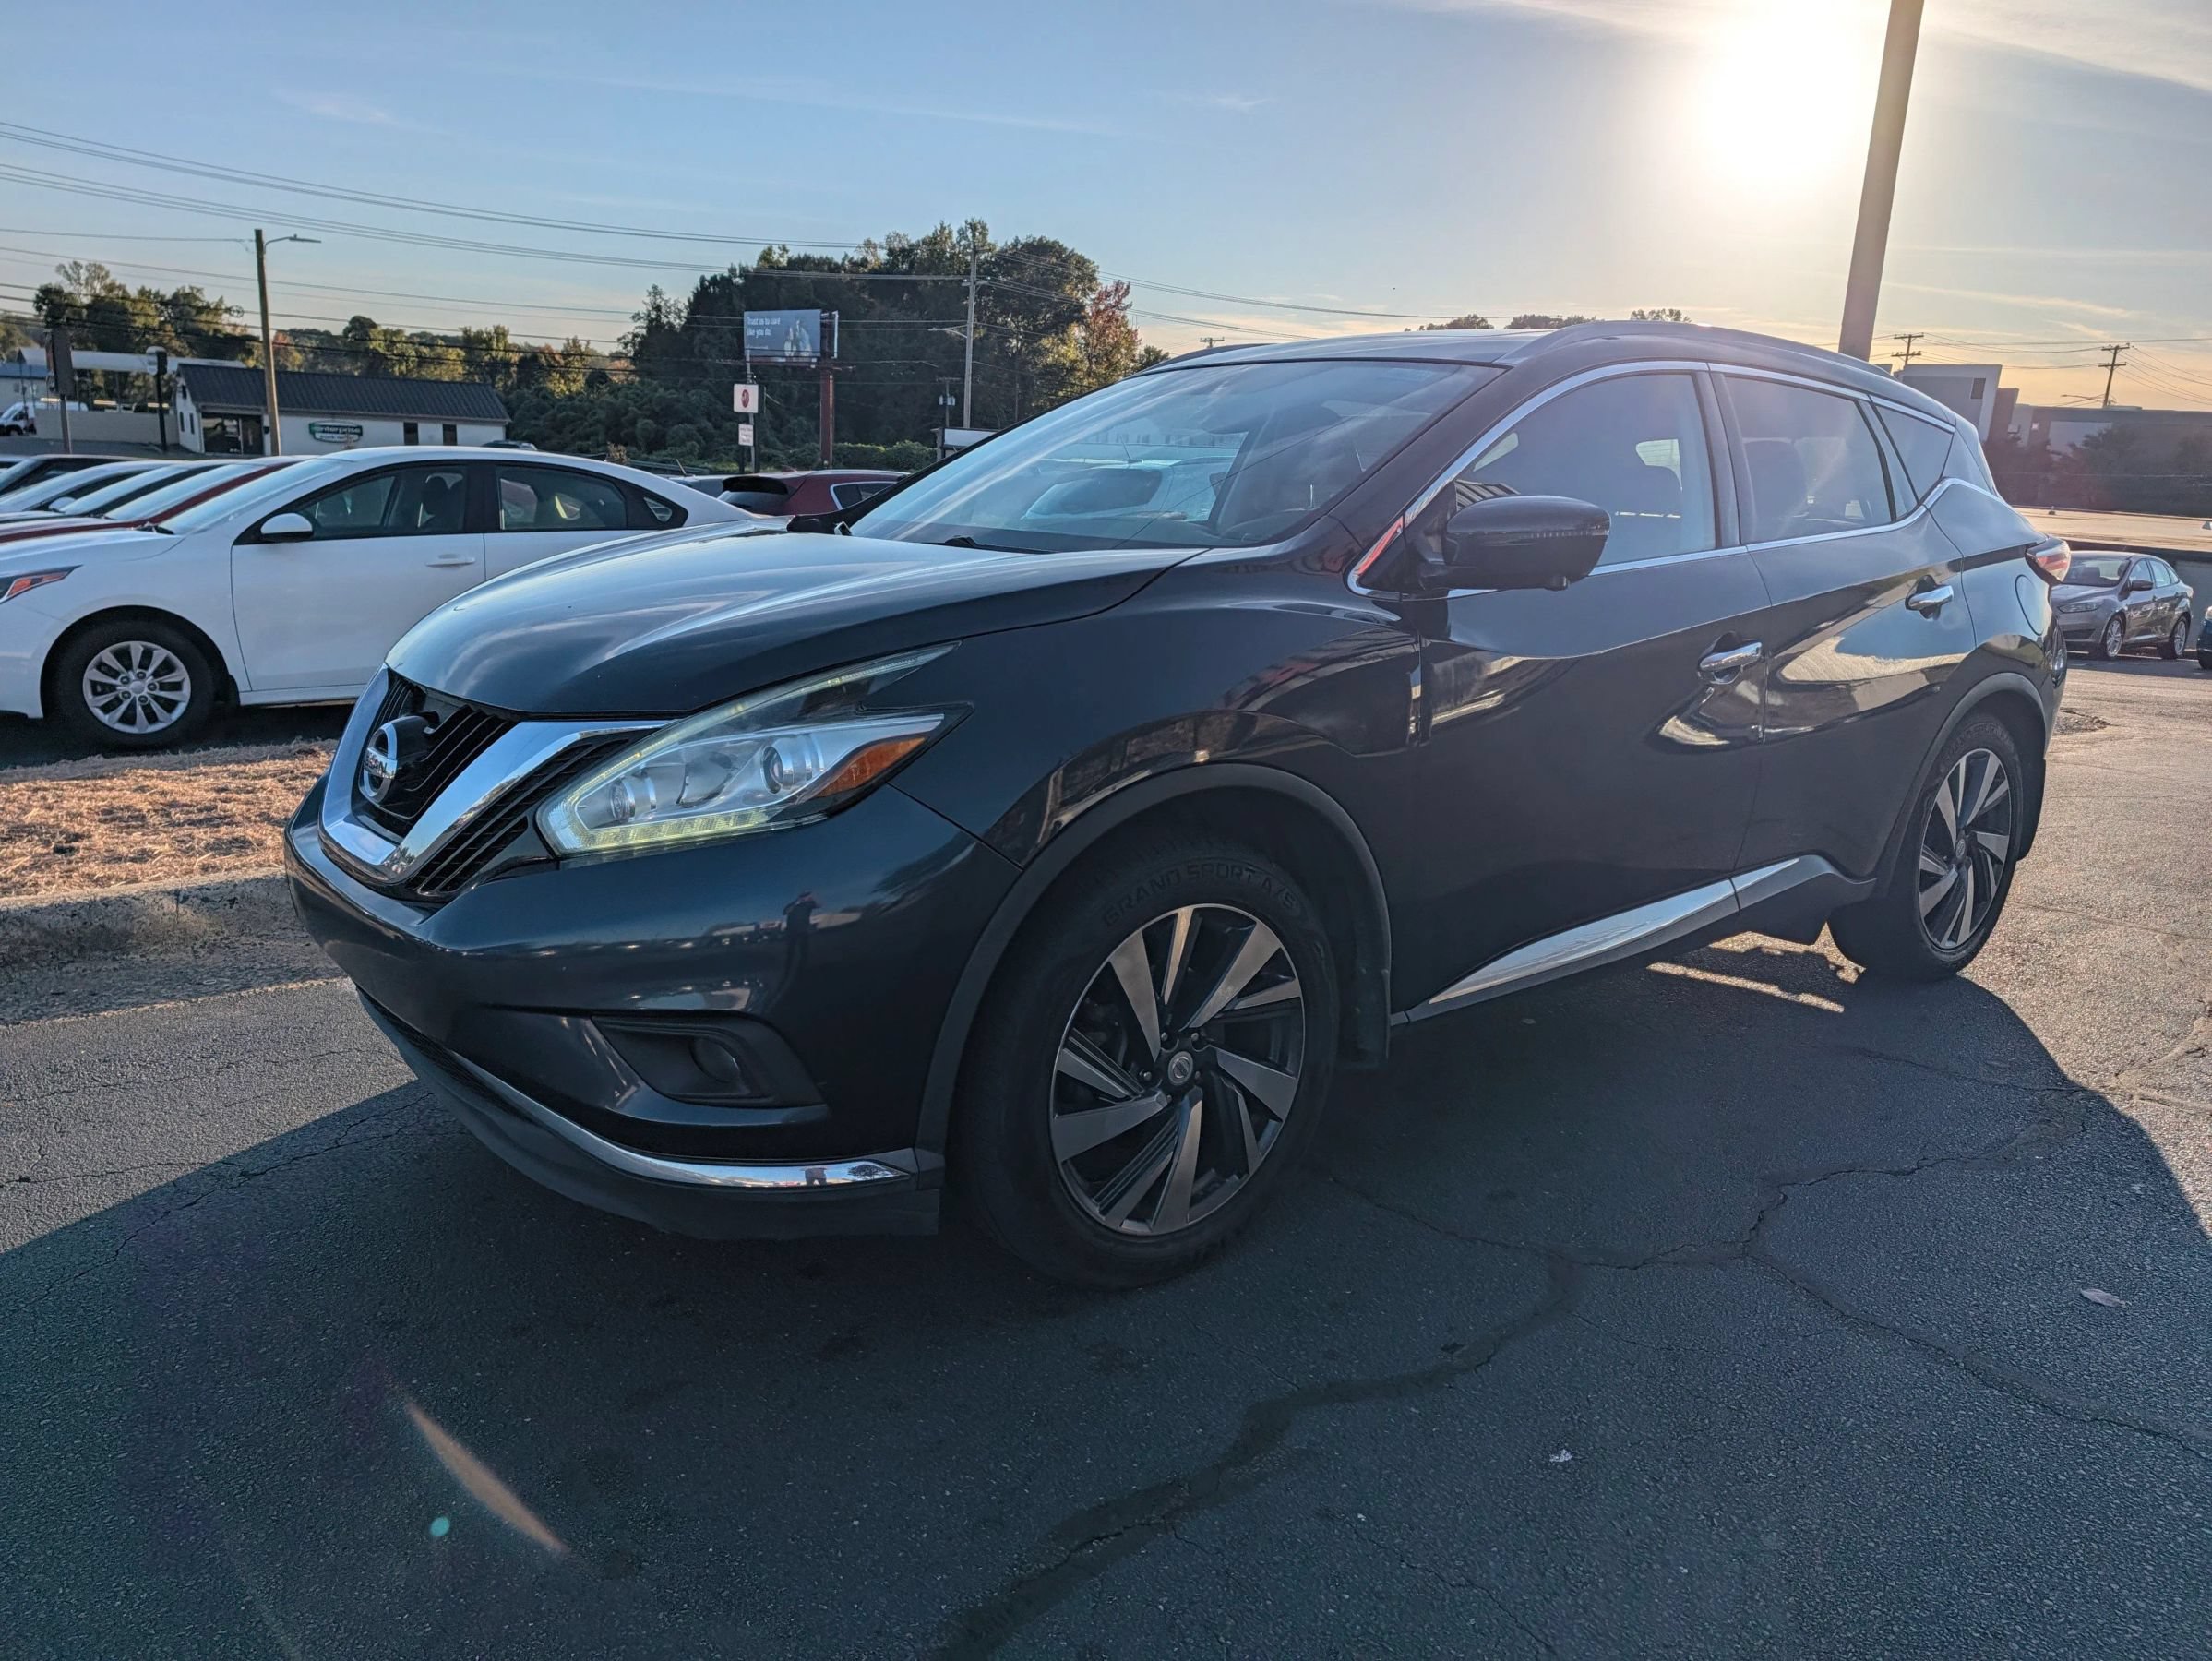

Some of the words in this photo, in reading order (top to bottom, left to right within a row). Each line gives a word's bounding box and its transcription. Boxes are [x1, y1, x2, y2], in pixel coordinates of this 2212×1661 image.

[1103, 869, 1182, 924] GRAND
[1187, 863, 1256, 885] SPORT
[1261, 878, 1299, 910] A/S
